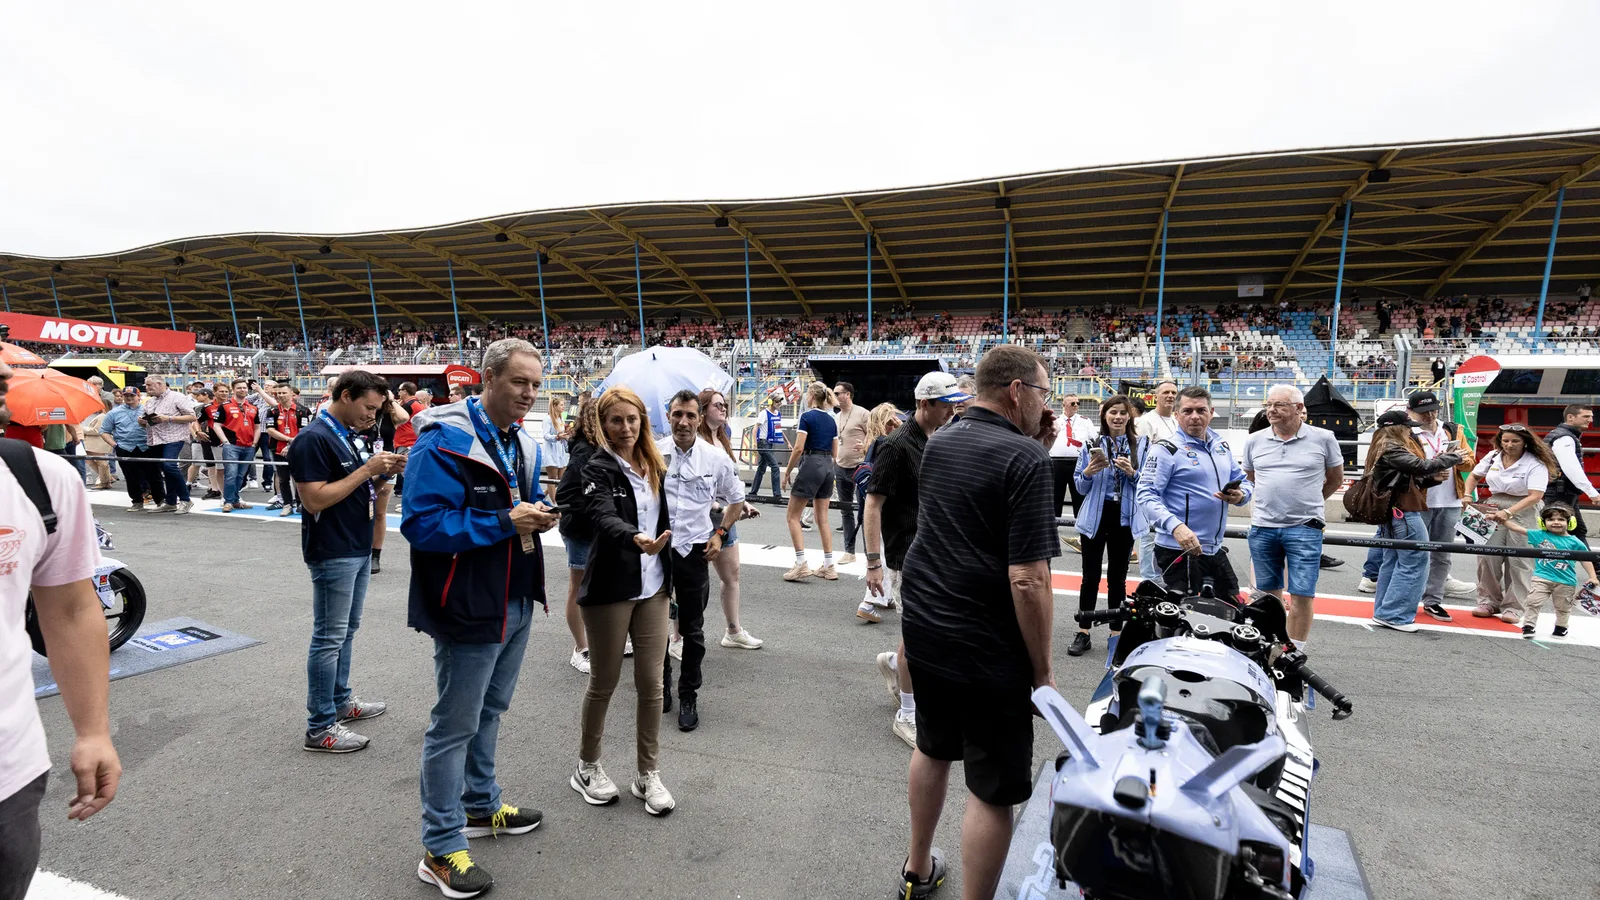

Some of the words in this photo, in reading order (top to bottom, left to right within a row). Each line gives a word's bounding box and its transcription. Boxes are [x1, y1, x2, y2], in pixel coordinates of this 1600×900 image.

[39, 320, 143, 347] MOTUL
[199, 352, 253, 368] 11:41:54
[449, 375, 470, 383] DUCATI
[1466, 374, 1488, 384] Castrol
[1246, 386, 1257, 397] C
[347, 707, 364, 718] N
[320, 735, 338, 749] N
